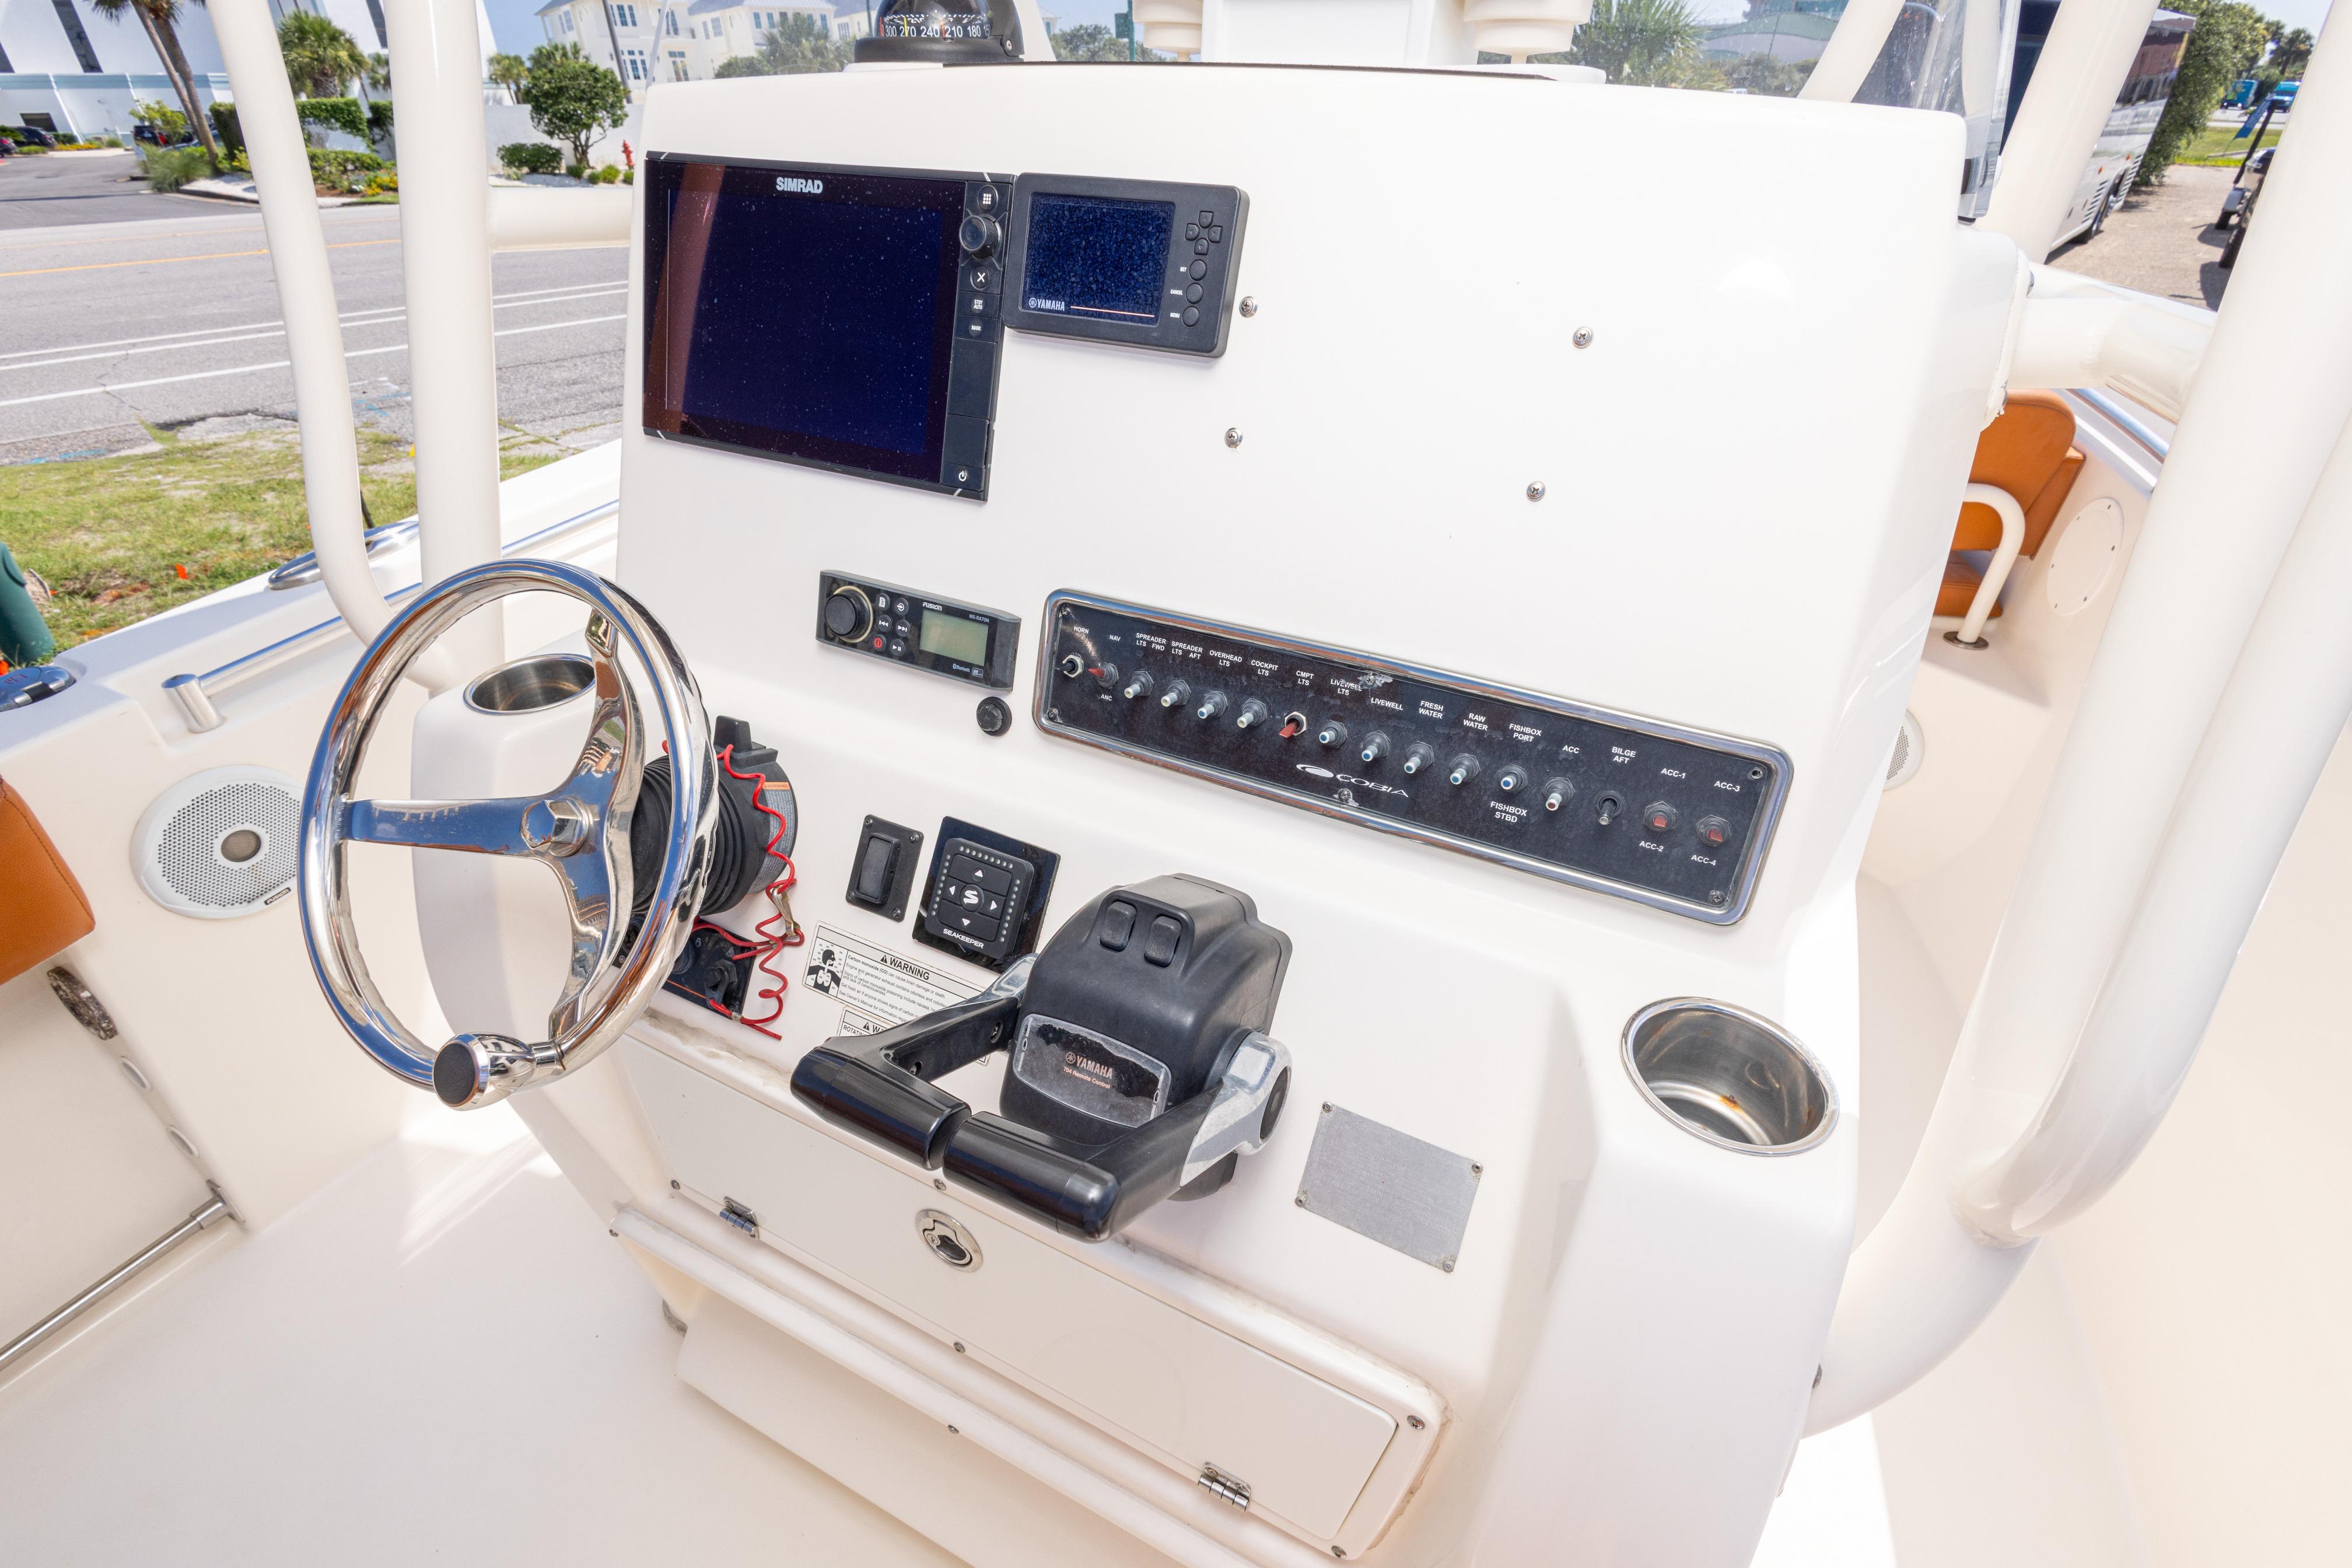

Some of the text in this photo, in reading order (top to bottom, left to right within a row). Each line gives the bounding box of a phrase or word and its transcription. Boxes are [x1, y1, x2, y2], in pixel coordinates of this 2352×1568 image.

[885, 25, 897, 37] 300
[900, 26, 916, 37] 270
[921, 26, 940, 37] 240
[945, 26, 963, 37] 210
[967, 25, 981, 37] 180
[776, 177, 823, 194] SIMRAD
[1037, 299, 1065, 312] YAMAHA
[923, 602, 942, 611] FUSION
[969, 614, 989, 623] MS-RA70N
[1074, 626, 1089, 634] HORN
[1136, 633, 1166, 644] SPREADER
[1152, 643, 1165, 651] FWD
[1171, 641, 1203, 653] SPREADER
[1209, 650, 1242, 663] OVERHEAD
[1219, 659, 1230, 667] LTS
[1251, 660, 1278, 672] COCKPIT
[1257, 668, 1269, 676] LTS
[1296, 670, 1314, 680] CMPT
[1298, 678, 1310, 686] LTS
[1330, 678, 1362, 692] LIVEWELL
[1337, 687, 1350, 696] LTS
[1371, 697, 1404, 711] LIVEWELL
[1420, 700, 1444, 712] FRESH
[1418, 707, 1443, 719] WATER
[1468, 713, 1486, 722] RAW
[1463, 719, 1488, 732] WATER
[1509, 723, 1542, 737] FISHBOX
[1513, 732, 1534, 743] PORT
[1562, 745, 1579, 754] ACC
[1611, 746, 1636, 758] BILGE
[1613, 755, 1630, 764] AFT
[1661, 768, 1686, 779] ACC-1
[1336, 774, 1409, 798] COBIA
[1714, 780, 1740, 792] ACC-3
[1490, 801, 1527, 817] FISHBOX
[1494, 811, 1518, 823] STBD
[1639, 841, 1664, 852] ACC-2
[1691, 855, 1717, 866] ACC-4
[943, 928, 984, 949] SEAKEEPER
[890, 957, 930, 980] WARNING
[861, 961, 879, 971] monoxide
[916, 984, 930, 992] damage
[861, 983, 886, 995] consciousness.
[865, 972, 881, 980] generator
[895, 984, 910, 993] contains
[910, 991, 925, 999] odorless
[870, 982, 886, 991] monoxide
[887, 989, 903, 1000] poisoning
[916, 1002, 930, 1011] nausea,
[846, 993, 860, 1002] Owner's
[860, 999, 873, 1008] Manual
[878, 1008, 897, 1019] information
[1076, 1055, 1113, 1079] YAMAHA
[1072, 1070, 1091, 1082] Remote
[1092, 1077, 1110, 1089] Control
